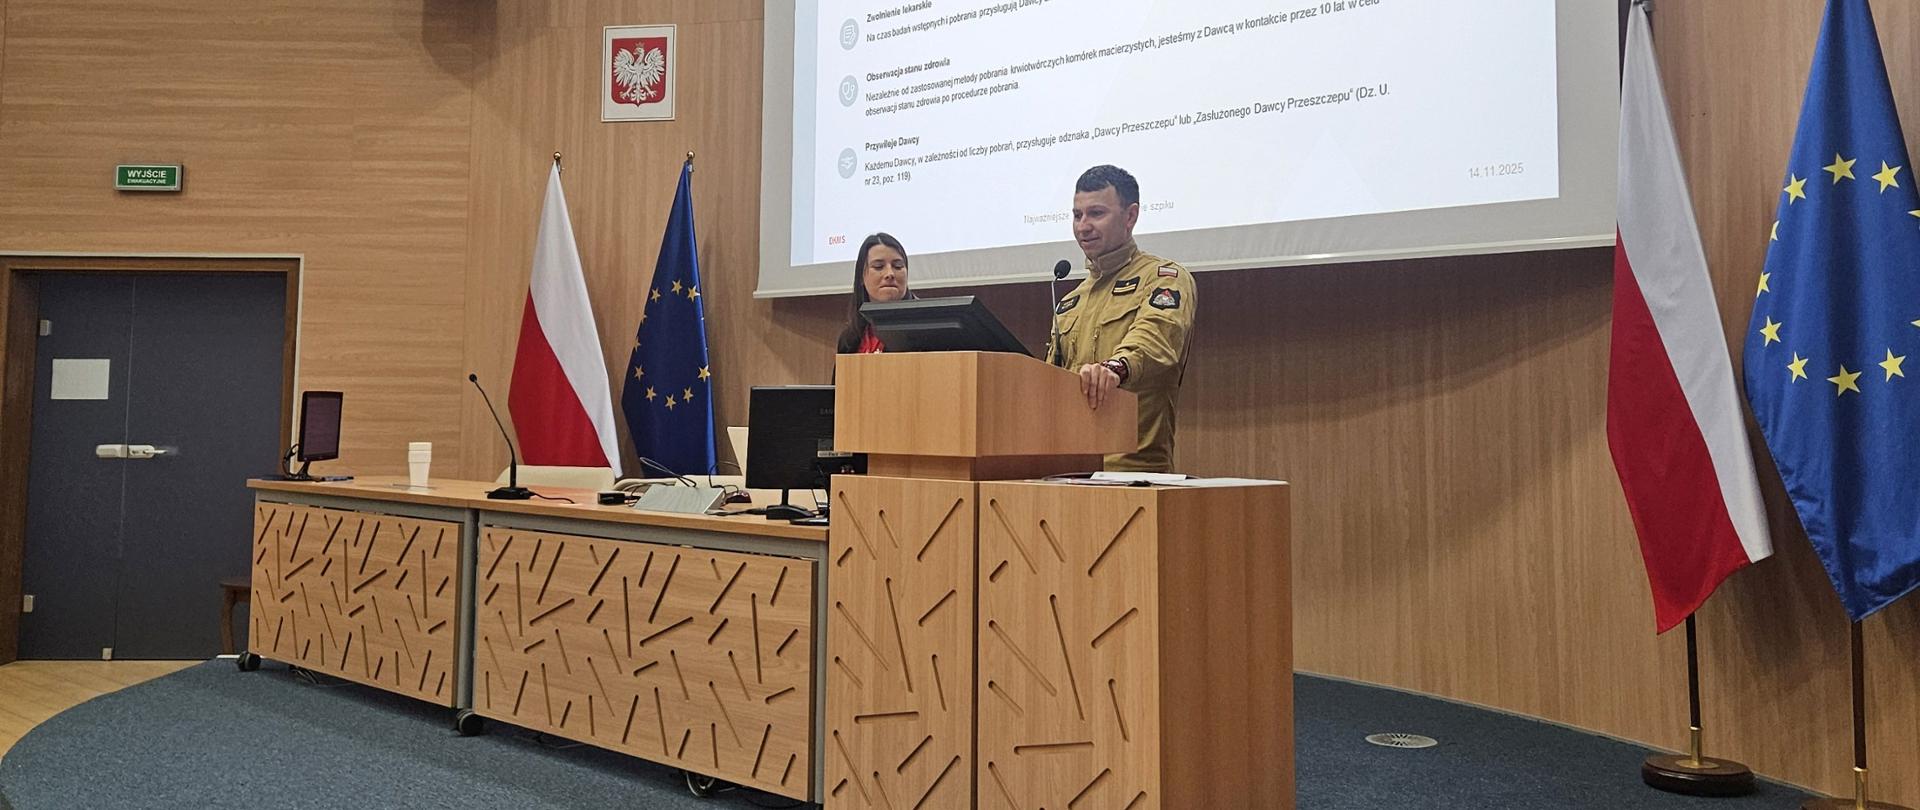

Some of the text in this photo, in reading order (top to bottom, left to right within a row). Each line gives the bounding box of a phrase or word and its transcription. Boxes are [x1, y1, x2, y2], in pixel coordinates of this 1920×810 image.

[866, 33, 875, 42] Na
[877, 31, 891, 40] czas
[892, 24, 911, 37] badań
[912, 17, 945, 31] wstępnych
[950, 11, 977, 25] pobrania
[979, 2, 1018, 19] przysługują
[867, 0, 932, 23] Zwolnienie lekarskie
[902, 86, 910, 95] od
[910, 78, 953, 94] zastosowanej
[954, 72, 978, 84] metody
[980, 67, 1008, 81] pobrania
[1010, 56, 1065, 74] krwiotwórczych
[1066, 49, 1097, 64] komórek
[1098, 38, 1157, 57] macierzystych,
[1158, 31, 1196, 48] jesteśmy
[1197, 30, 1202, 39] z
[1204, 24, 1234, 37] Dawcą
[1236, 22, 1244, 31] w
[1245, 12, 1287, 29] kontakcie
[1290, 8, 1317, 23] przez
[1320, 2, 1331, 15] 10
[1334, 2, 1345, 12] lat
[1348, 0, 1357, 9] w
[866, 57, 951, 82] Obserwacja stanu zdrowia
[866, 104, 898, 117] obserwacji
[898, 101, 915, 111] stanu
[916, 95, 941, 108] zdrowia
[942, 94, 950, 105] po
[952, 87, 988, 102] procedurze
[865, 158, 893, 171] Każdemu
[894, 156, 917, 168] Dawcy,
[918, 156, 924, 164] w
[925, 148, 959, 163] zależności
[960, 148, 968, 158] od
[969, 144, 988, 156] liczby
[990, 140, 1015, 155] pobrań,
[1016, 134, 1056, 150] przysługuje
[1059, 129, 1090, 143] odznaka
[1179, 114, 1192, 125] lub
[1254, 101, 1285, 114] Dawcy
[1356, 86, 1377, 101] (Dz.
[1379, 84, 1390, 96] U.
[866, 135, 920, 152] Przywileje Dawcy
[128, 169, 167, 178] WYJŚCIE
[865, 178, 872, 186] nr
[898, 171, 911, 182] 119)
